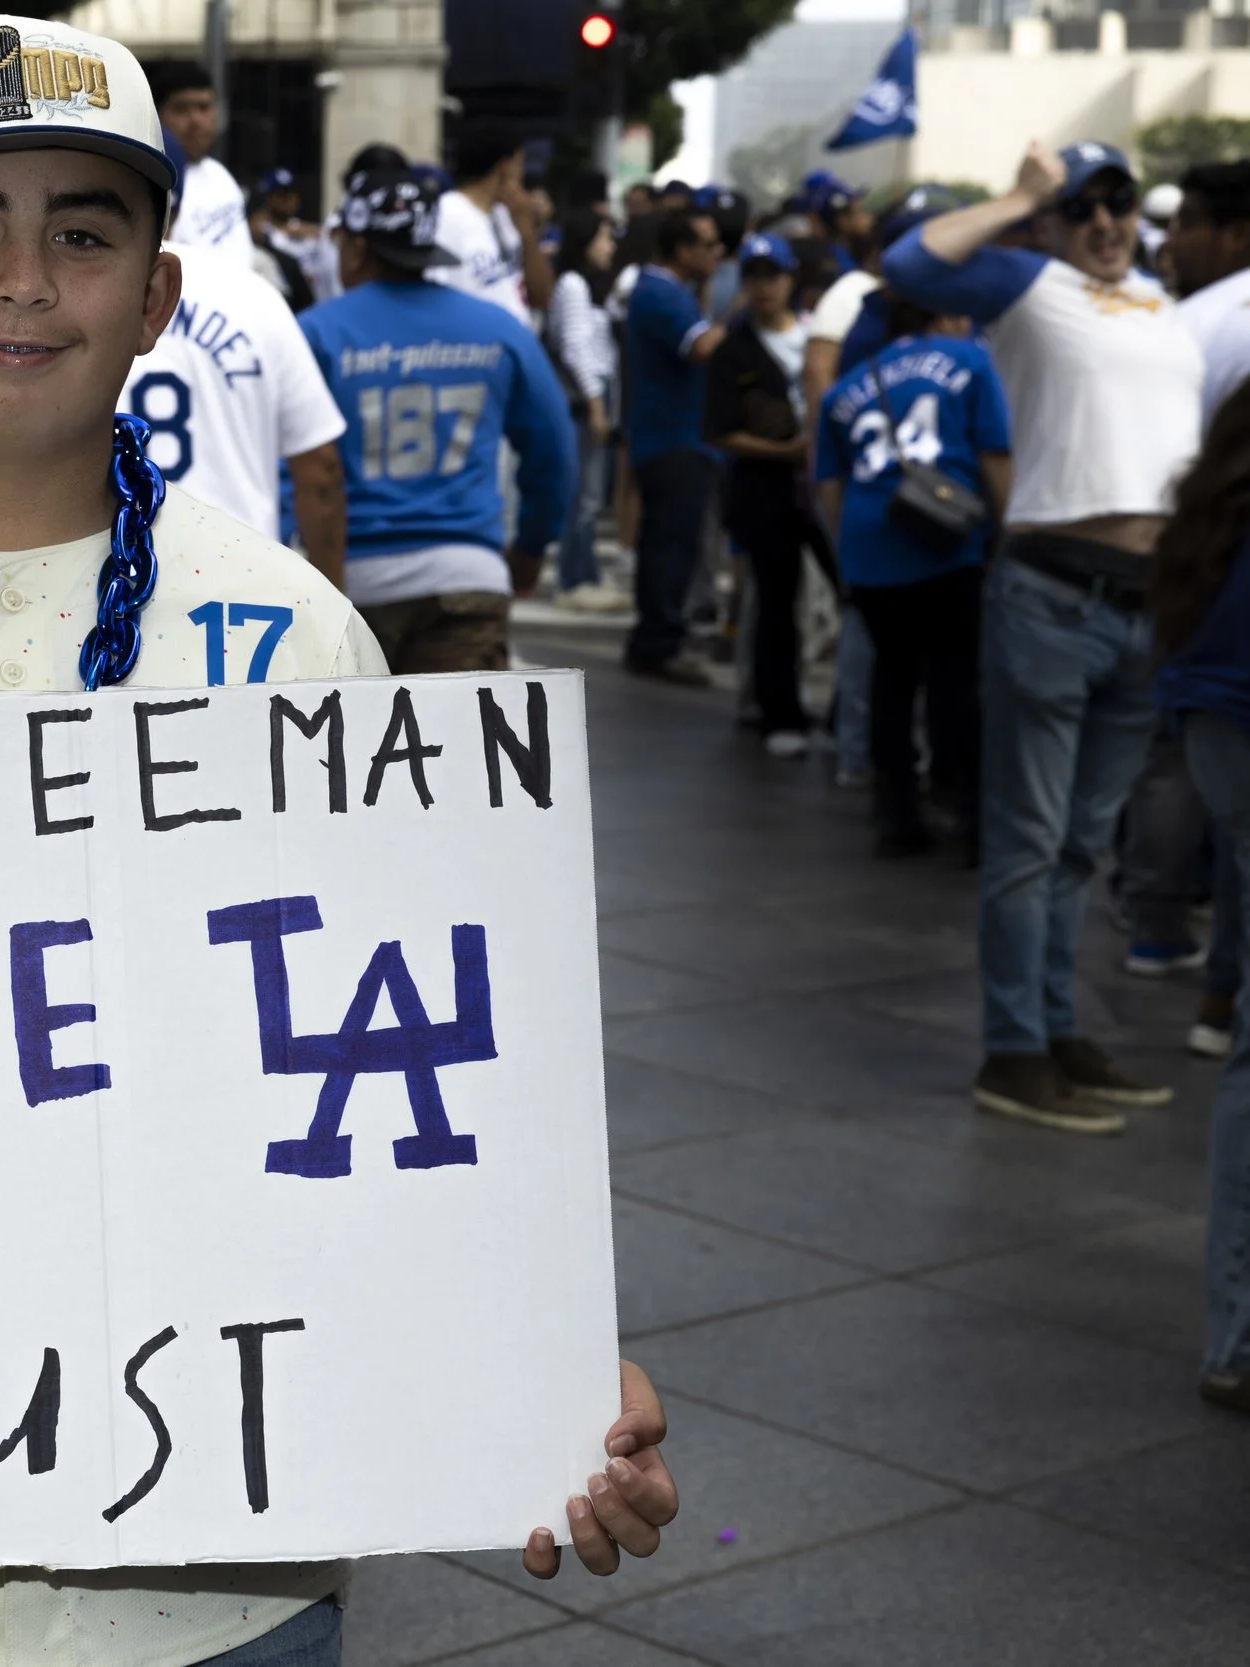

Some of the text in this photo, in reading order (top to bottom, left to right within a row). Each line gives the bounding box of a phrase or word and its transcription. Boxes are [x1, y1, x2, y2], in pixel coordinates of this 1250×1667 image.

[130, 372, 193, 482] 8
[359, 382, 488, 480] 187
[187, 600, 293, 688] 17
[206, 895, 499, 1181] LA
